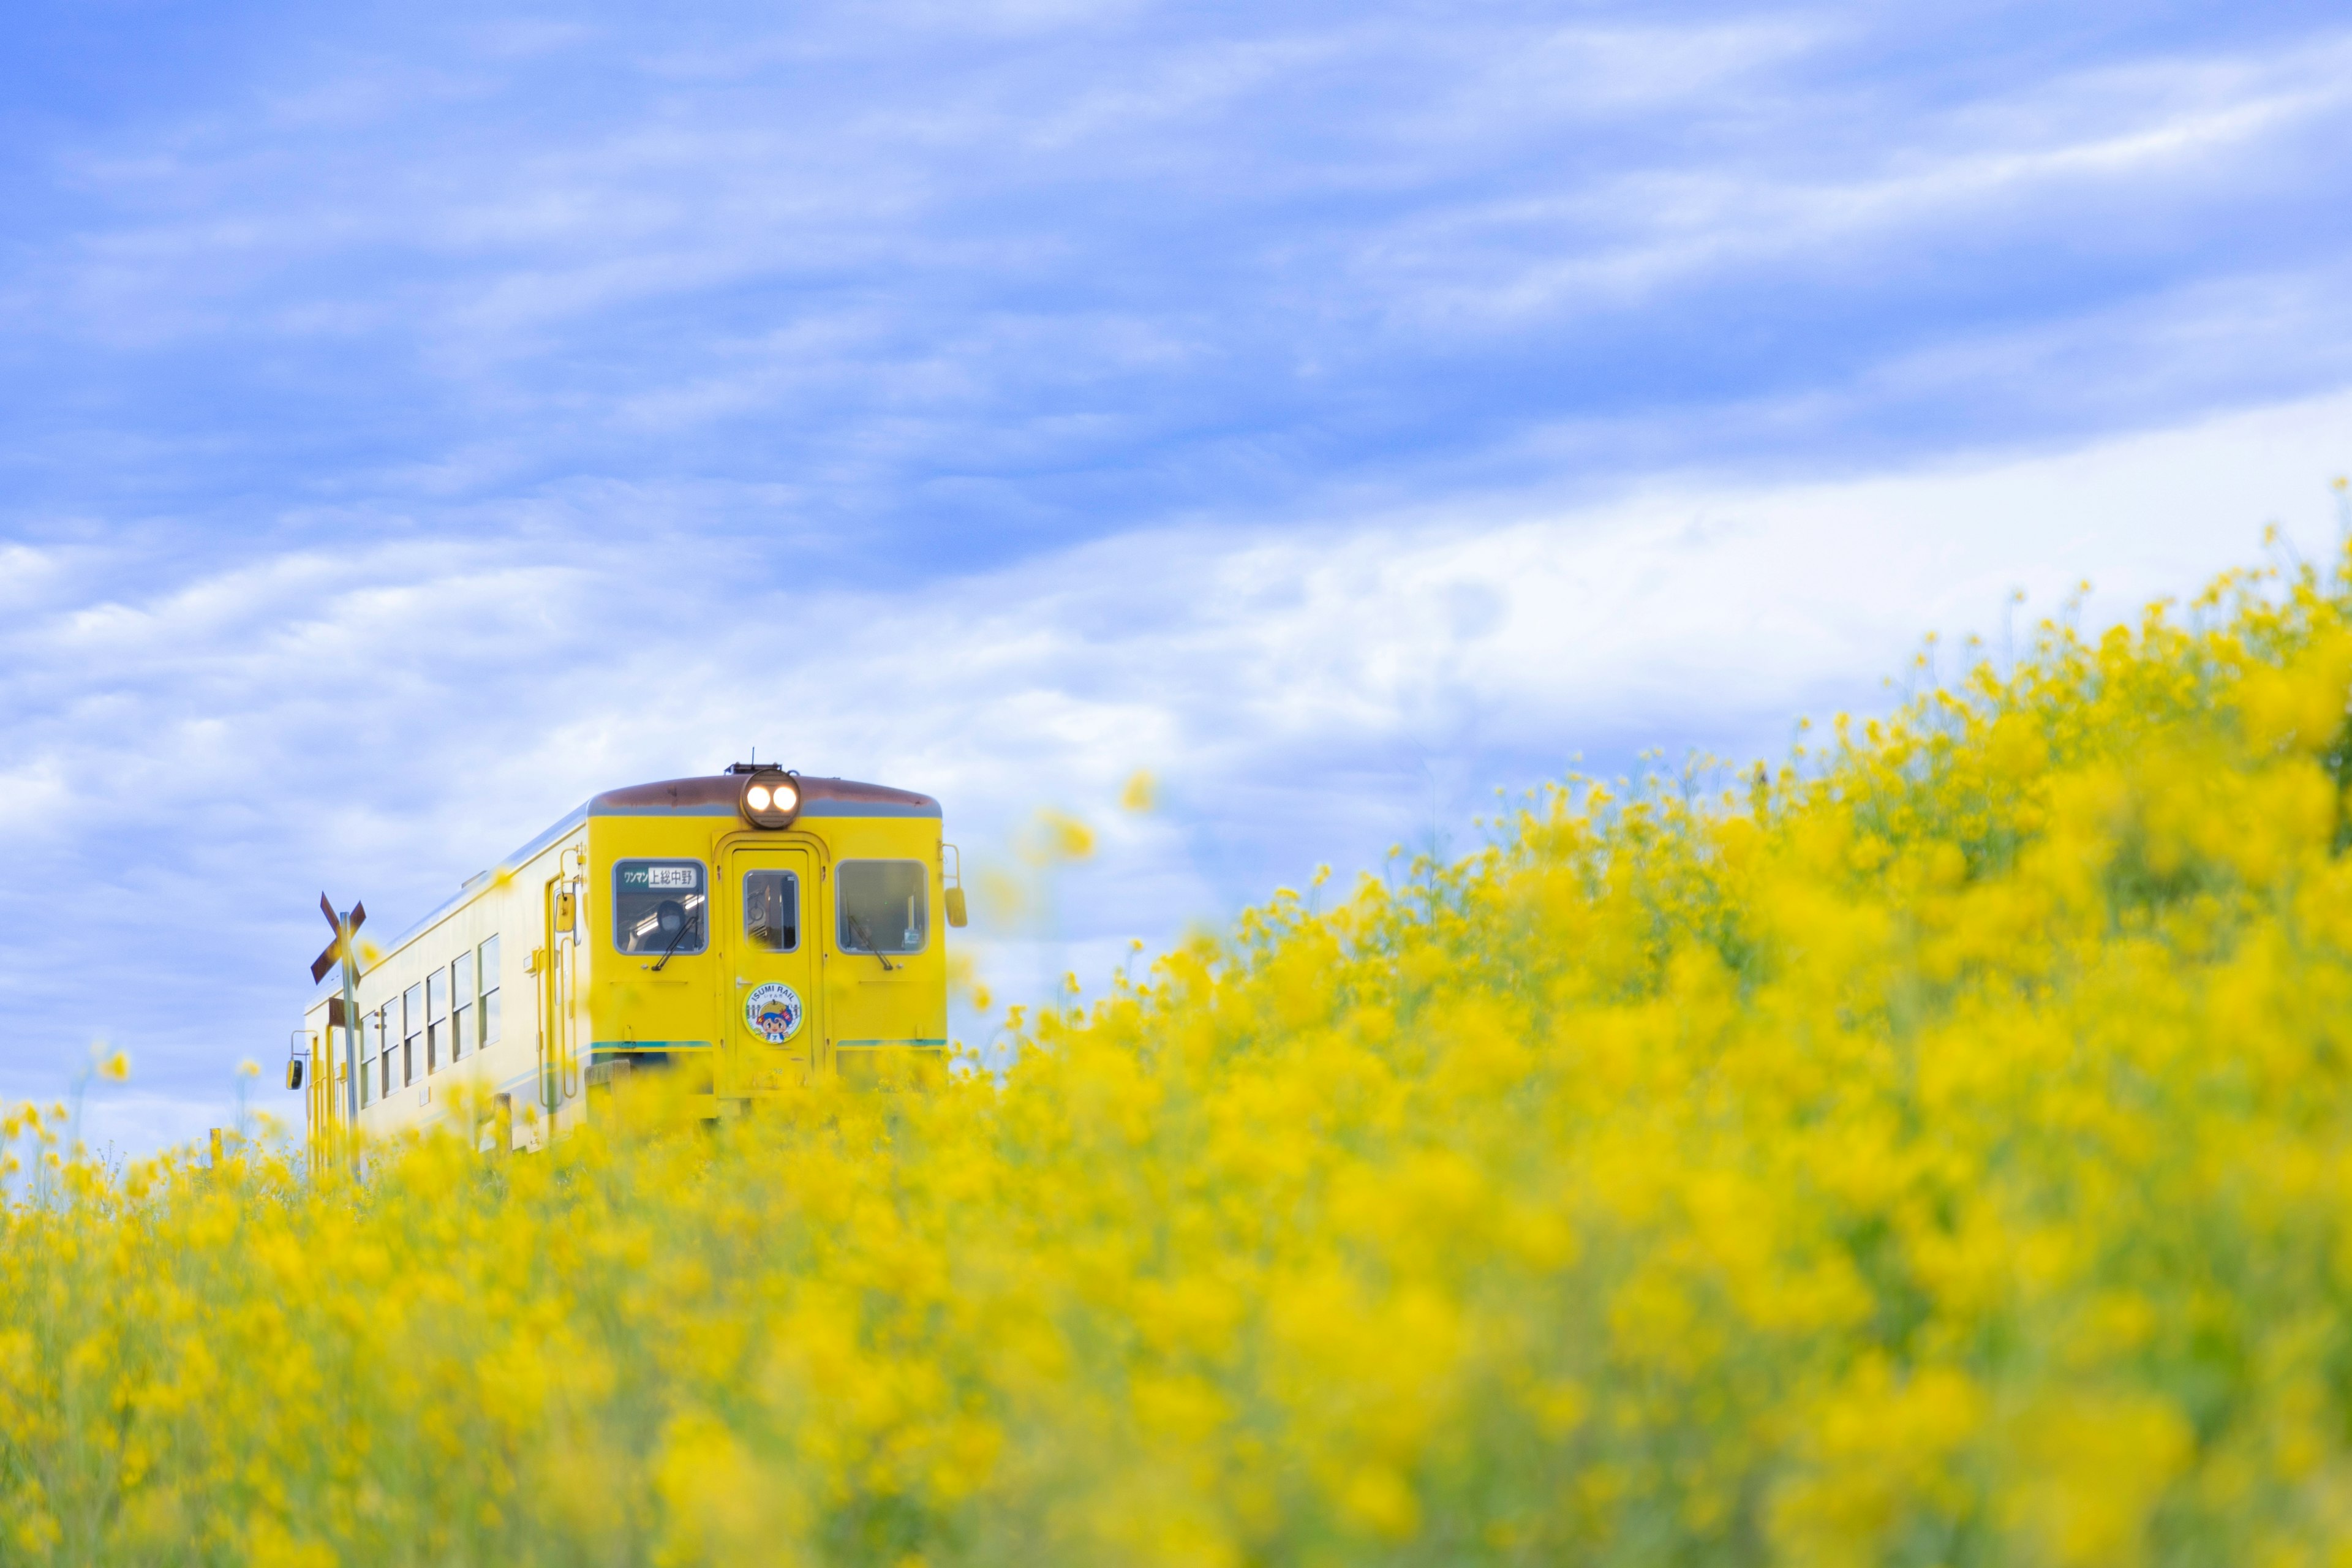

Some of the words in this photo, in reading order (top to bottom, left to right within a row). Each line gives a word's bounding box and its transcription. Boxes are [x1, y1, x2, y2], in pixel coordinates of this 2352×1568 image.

[624, 872, 648, 883] ワンマン
[650, 870, 692, 885] 上総中野
[752, 985, 774, 1001] ISUMI
[777, 986, 794, 1002] RAIL
